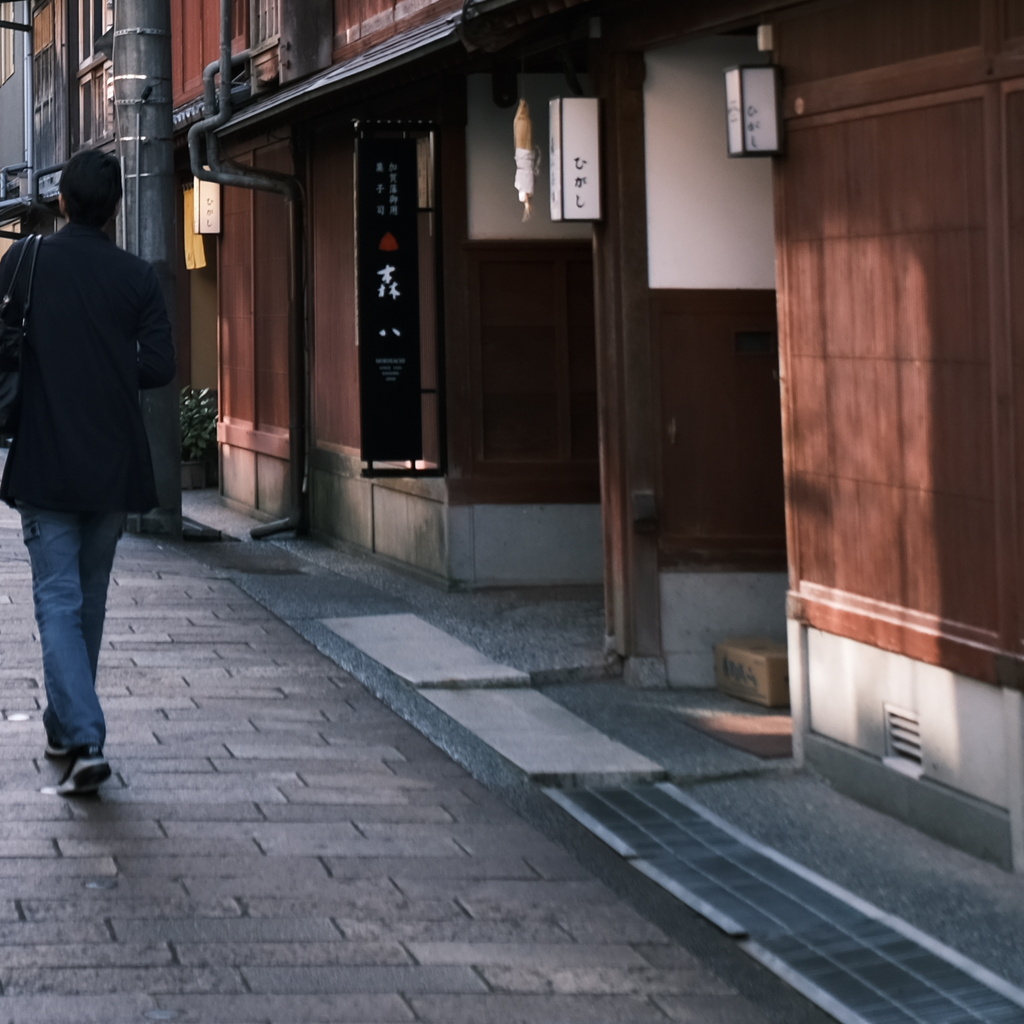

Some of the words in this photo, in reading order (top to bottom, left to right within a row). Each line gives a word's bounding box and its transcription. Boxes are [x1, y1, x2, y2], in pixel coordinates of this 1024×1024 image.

[573, 156, 588, 208] ひがし
[206, 198, 214, 227] ひがし
[376, 264, 402, 338] 森八
